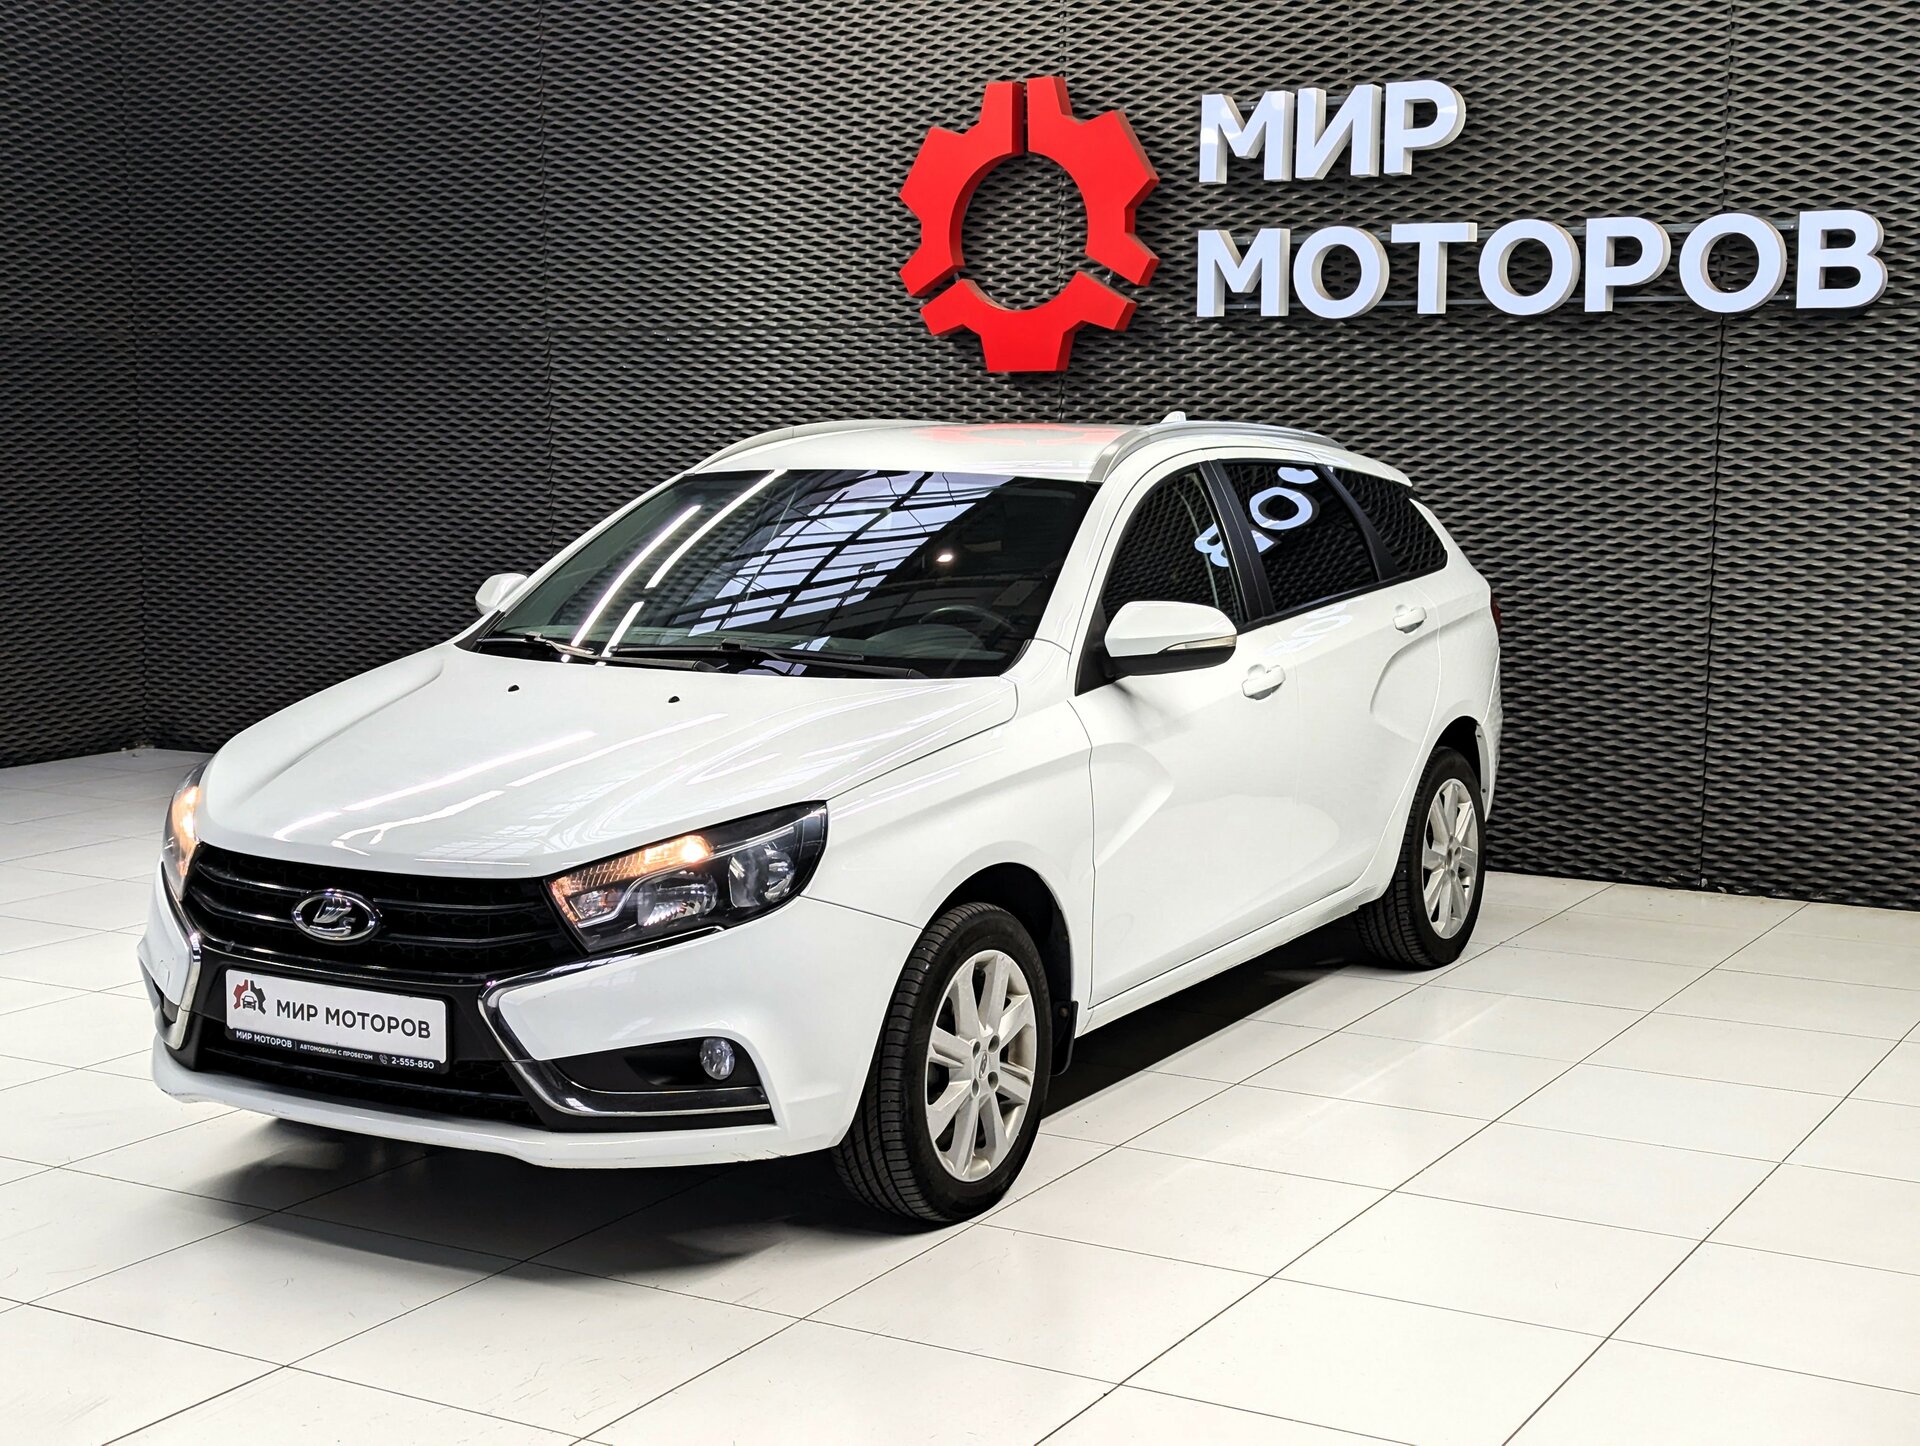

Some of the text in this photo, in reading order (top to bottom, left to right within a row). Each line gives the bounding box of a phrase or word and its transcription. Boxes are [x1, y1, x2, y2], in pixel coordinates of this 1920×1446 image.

[1199, 80, 1466, 184] МИР
[1197, 209, 1888, 319] МОТОРОВ
[276, 999, 431, 1039] МИР МОТОРОВ
[236, 1030, 293, 1048] МИР МОТОРОВ
[299, 1043, 337, 1055] АВТОМОБИЛИ
[343, 1050, 374, 1060] ПРОБЕГОМ
[391, 1056, 435, 1070] 2-555-850
